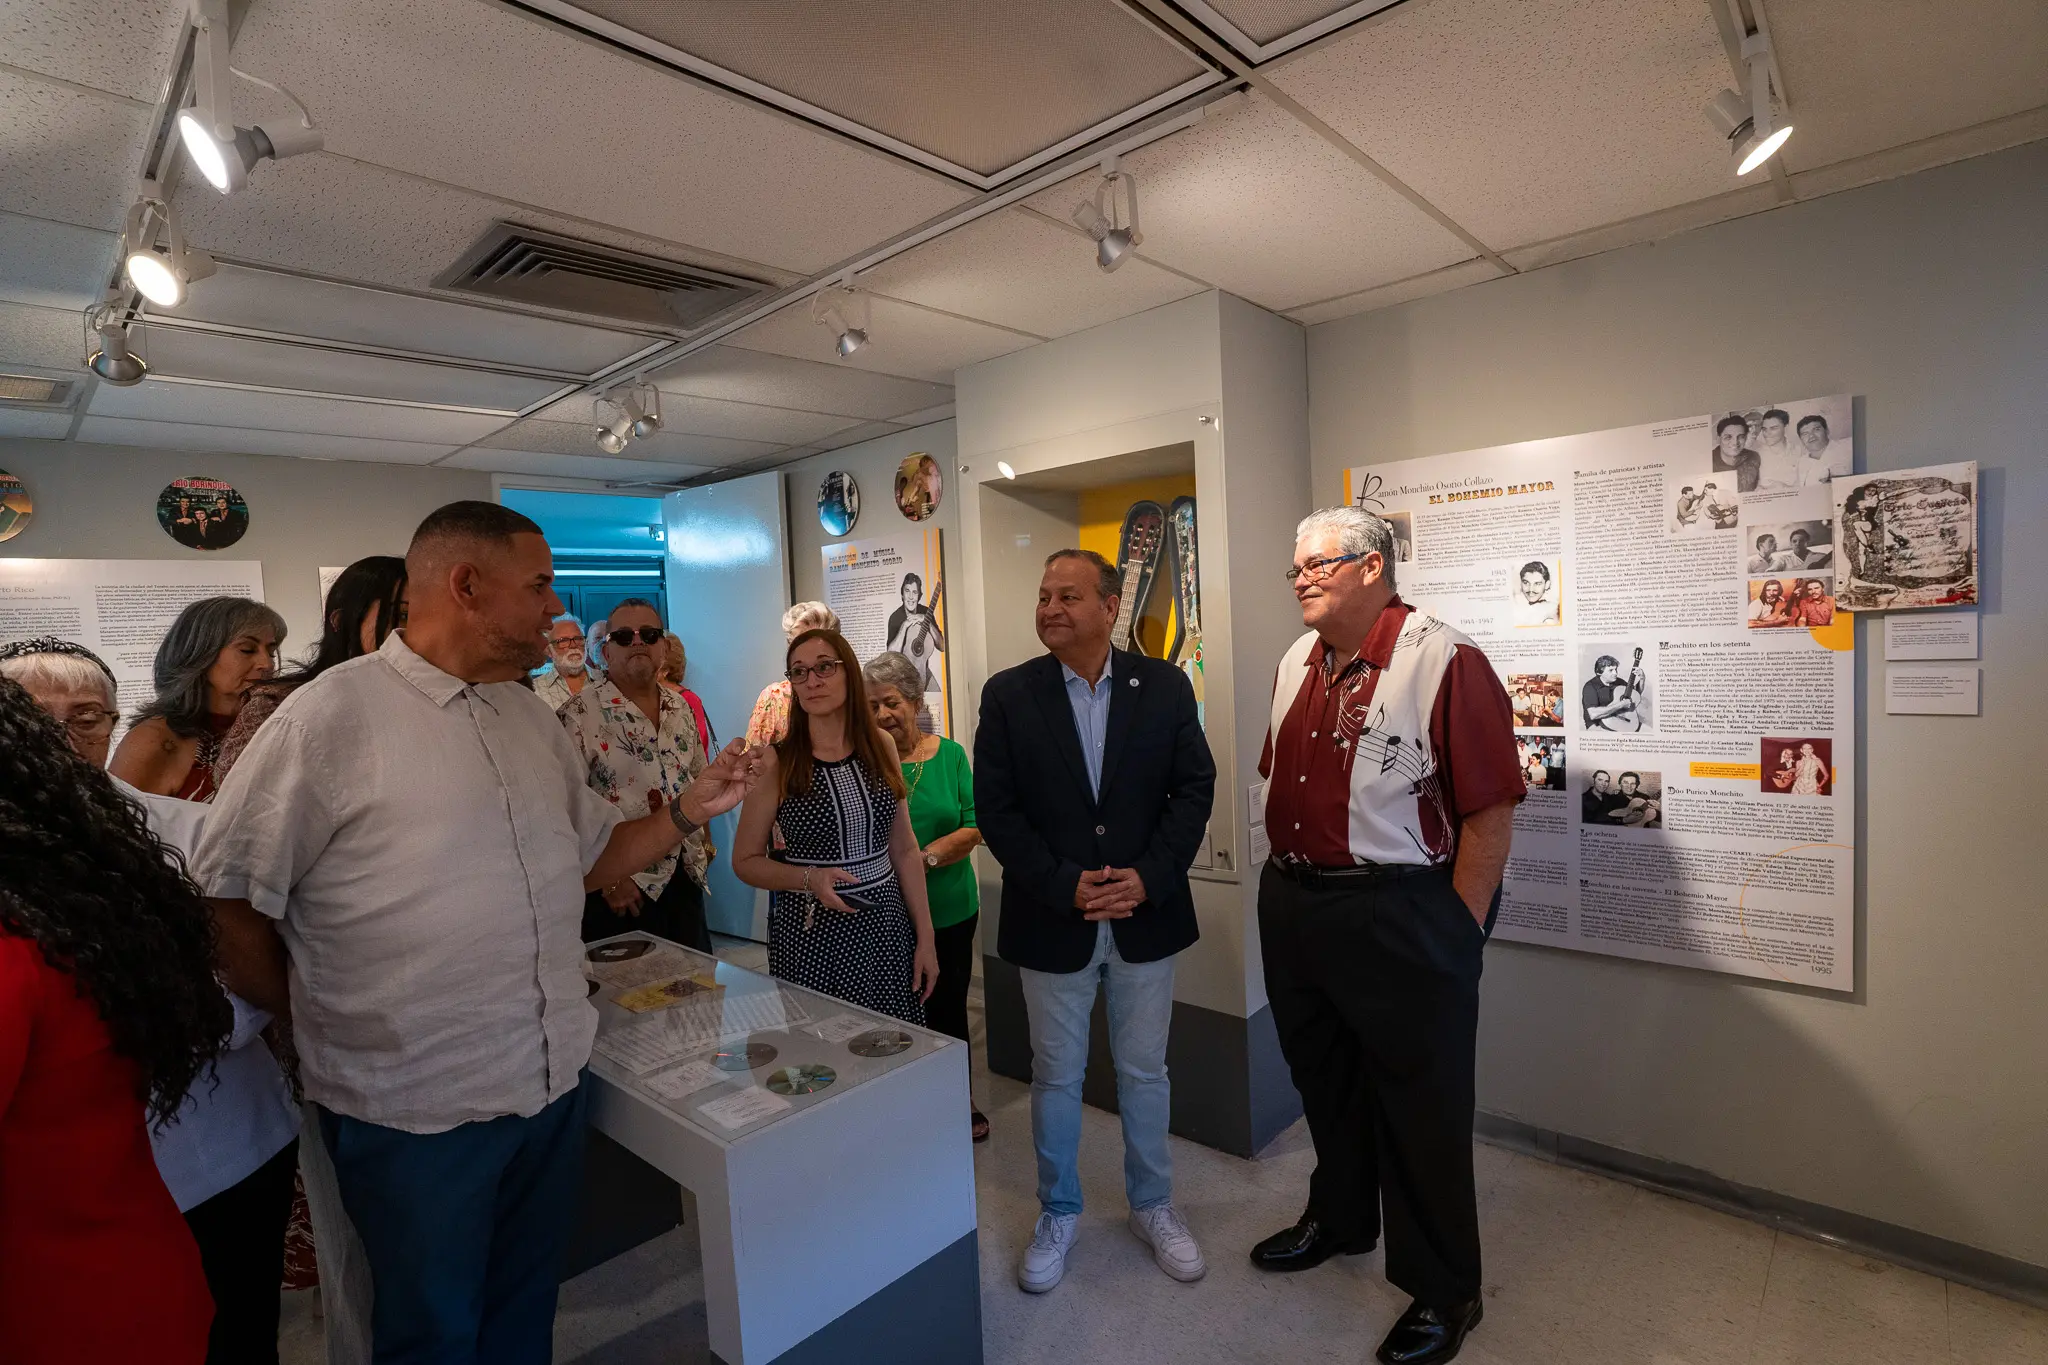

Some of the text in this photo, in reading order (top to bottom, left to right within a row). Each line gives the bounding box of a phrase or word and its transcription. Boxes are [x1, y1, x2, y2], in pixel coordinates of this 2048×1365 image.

[1608, 465, 1636, 476] patriotas
[1642, 462, 1665, 470] artistas
[1357, 472, 1494, 509] Ramón Monchito Osorio Collazo
[1428, 480, 1555, 504] EL BOHEMIO MAYOR
[1659, 642, 1697, 650] Monchito
[1580, 879, 1610, 889] Monchito
[1674, 890, 1704, 899] Bohemio
[1706, 893, 1728, 902] Mayor
[1811, 965, 1832, 974] 1995
